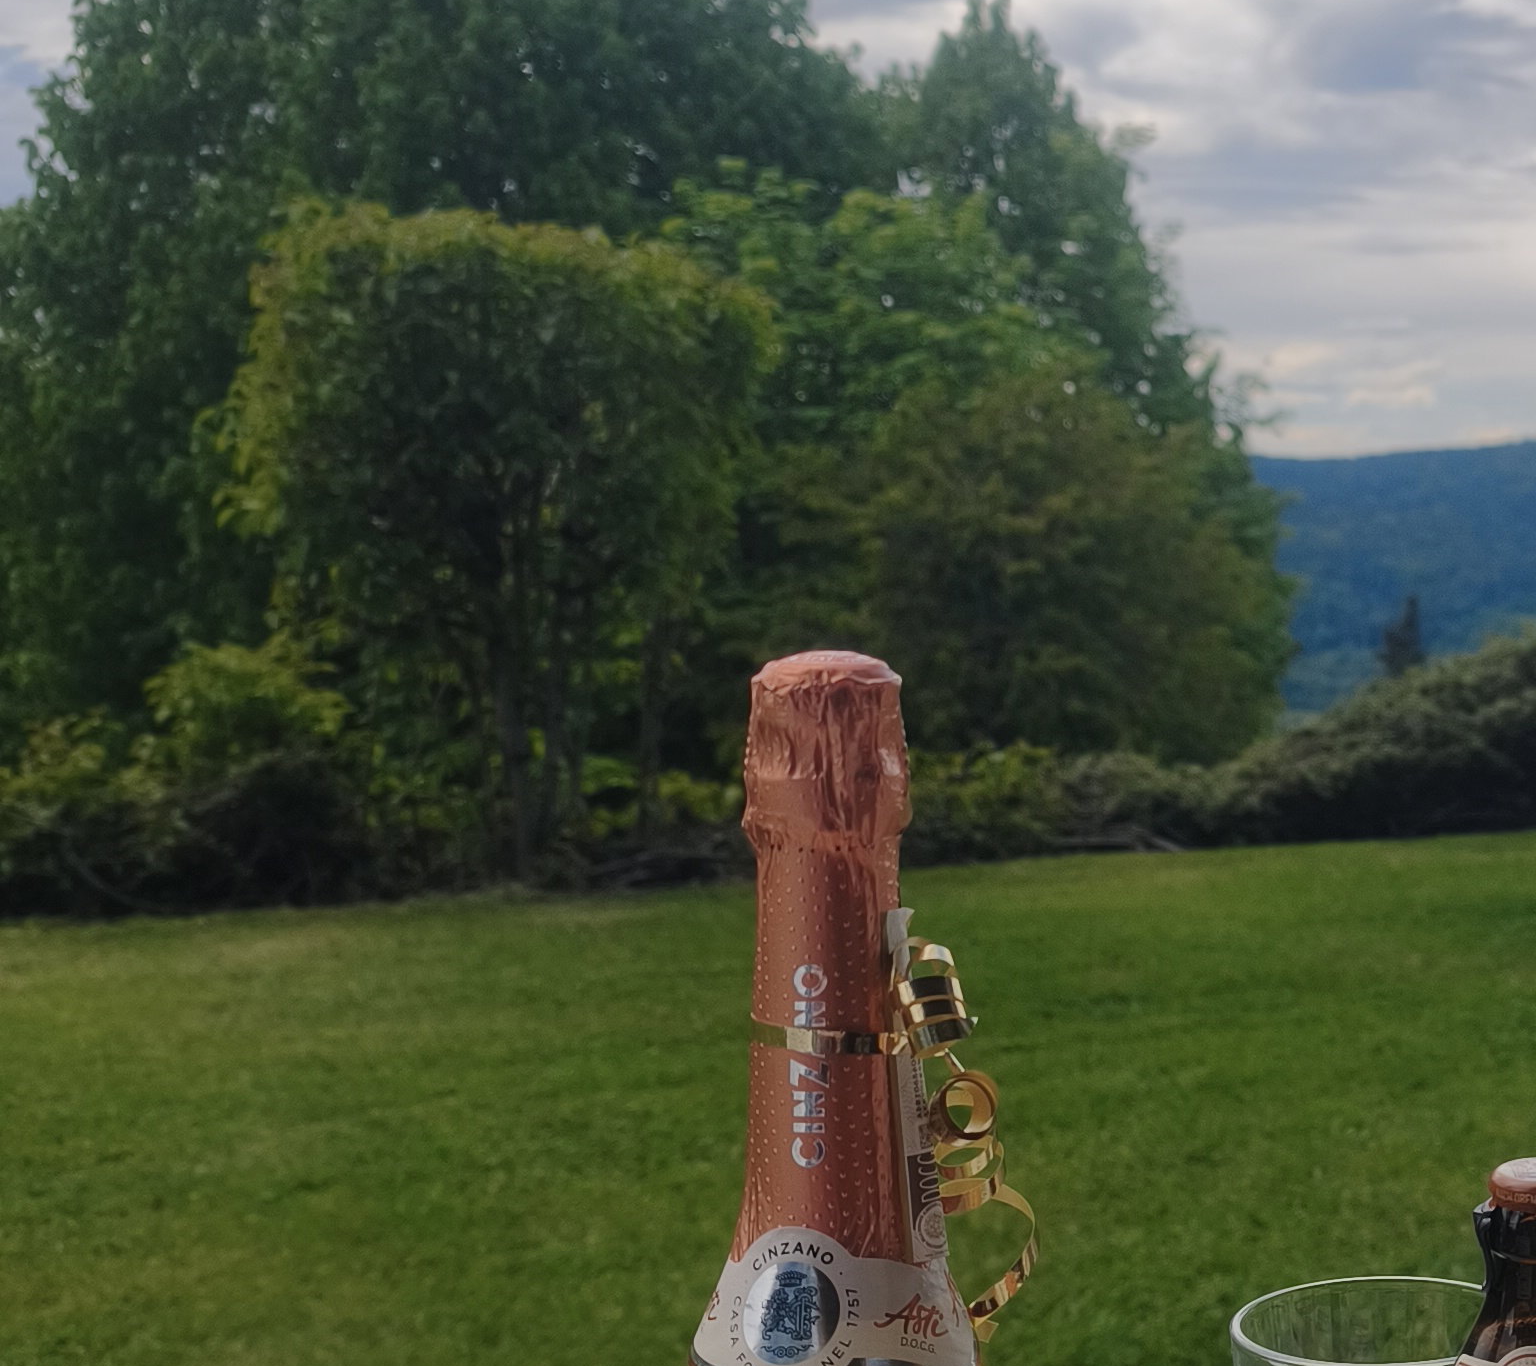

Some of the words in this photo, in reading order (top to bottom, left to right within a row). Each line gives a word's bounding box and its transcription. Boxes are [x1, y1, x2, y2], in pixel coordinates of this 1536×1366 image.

[789, 963, 830, 1168] CINZNO
[752, 1241, 834, 1271] CINZANO
[729, 1295, 742, 1348] CASA
[847, 1288, 860, 1327] 1757
[873, 1293, 949, 1339] Asti
